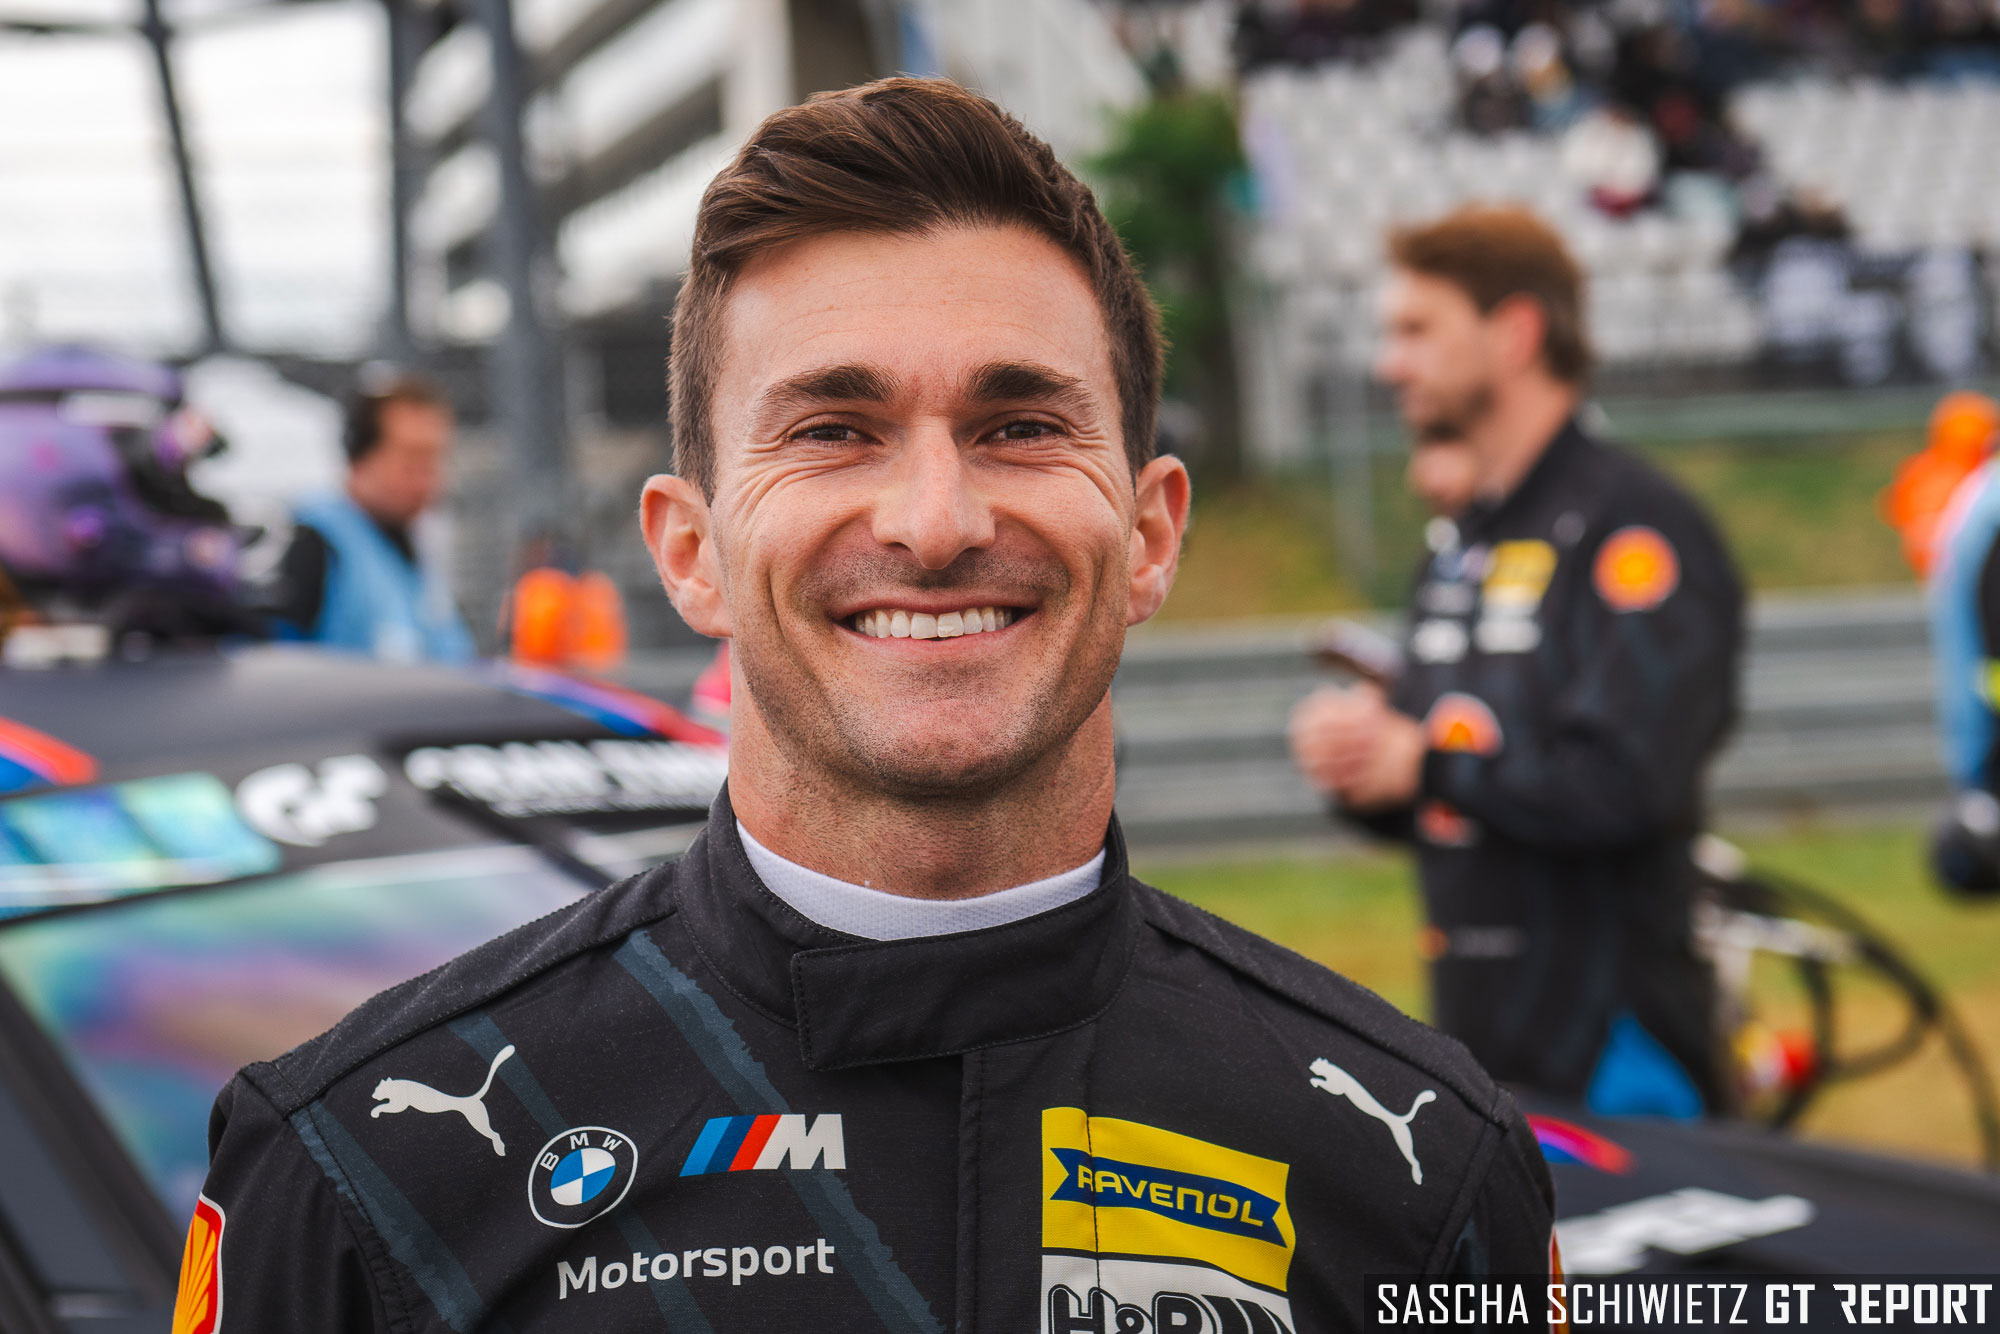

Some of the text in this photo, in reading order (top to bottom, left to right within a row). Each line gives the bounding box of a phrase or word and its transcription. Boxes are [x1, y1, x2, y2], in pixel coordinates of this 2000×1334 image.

[540, 1132, 623, 1171] BMW
[1078, 1164, 1264, 1227] RAVENOL
[557, 1238, 835, 1299] Motorsport
